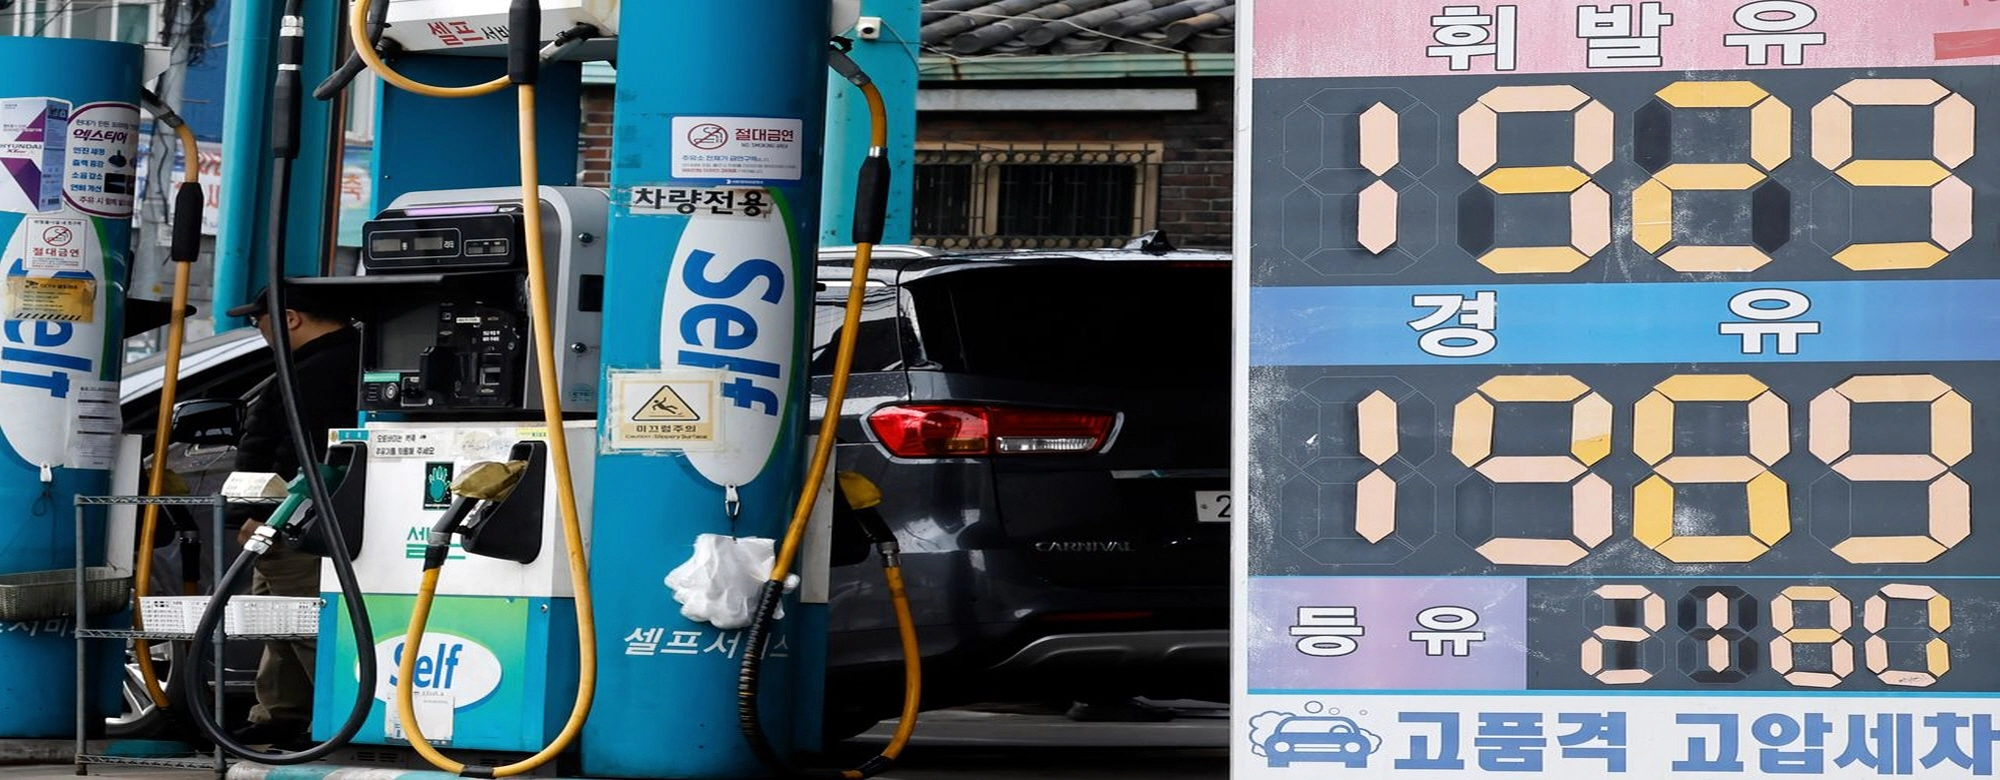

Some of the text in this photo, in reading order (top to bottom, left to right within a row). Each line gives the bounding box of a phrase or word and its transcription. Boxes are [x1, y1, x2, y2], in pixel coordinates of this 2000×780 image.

[427, 21, 510, 46] 셀프 서비
[1427, 0, 1826, 71] 휘발유
[73, 128, 128, 144] 엑스티어
[735, 128, 794, 142] 절대금연
[1357, 77, 1976, 274] 1929
[635, 187, 768, 217] 차량전용
[33, 247, 80, 258] 절대금연
[679, 249, 785, 417] Self
[636, 425, 696, 433] 미끄럼주의
[416, 446, 435, 455] 주세요
[1355, 373, 1973, 566] 1989
[1035, 541, 1135, 551] CARNIVAL
[1290, 604, 1486, 657] 등유
[1581, 583, 1951, 688] 2180
[1394, 711, 2000, 776] 고품격 고압세차
